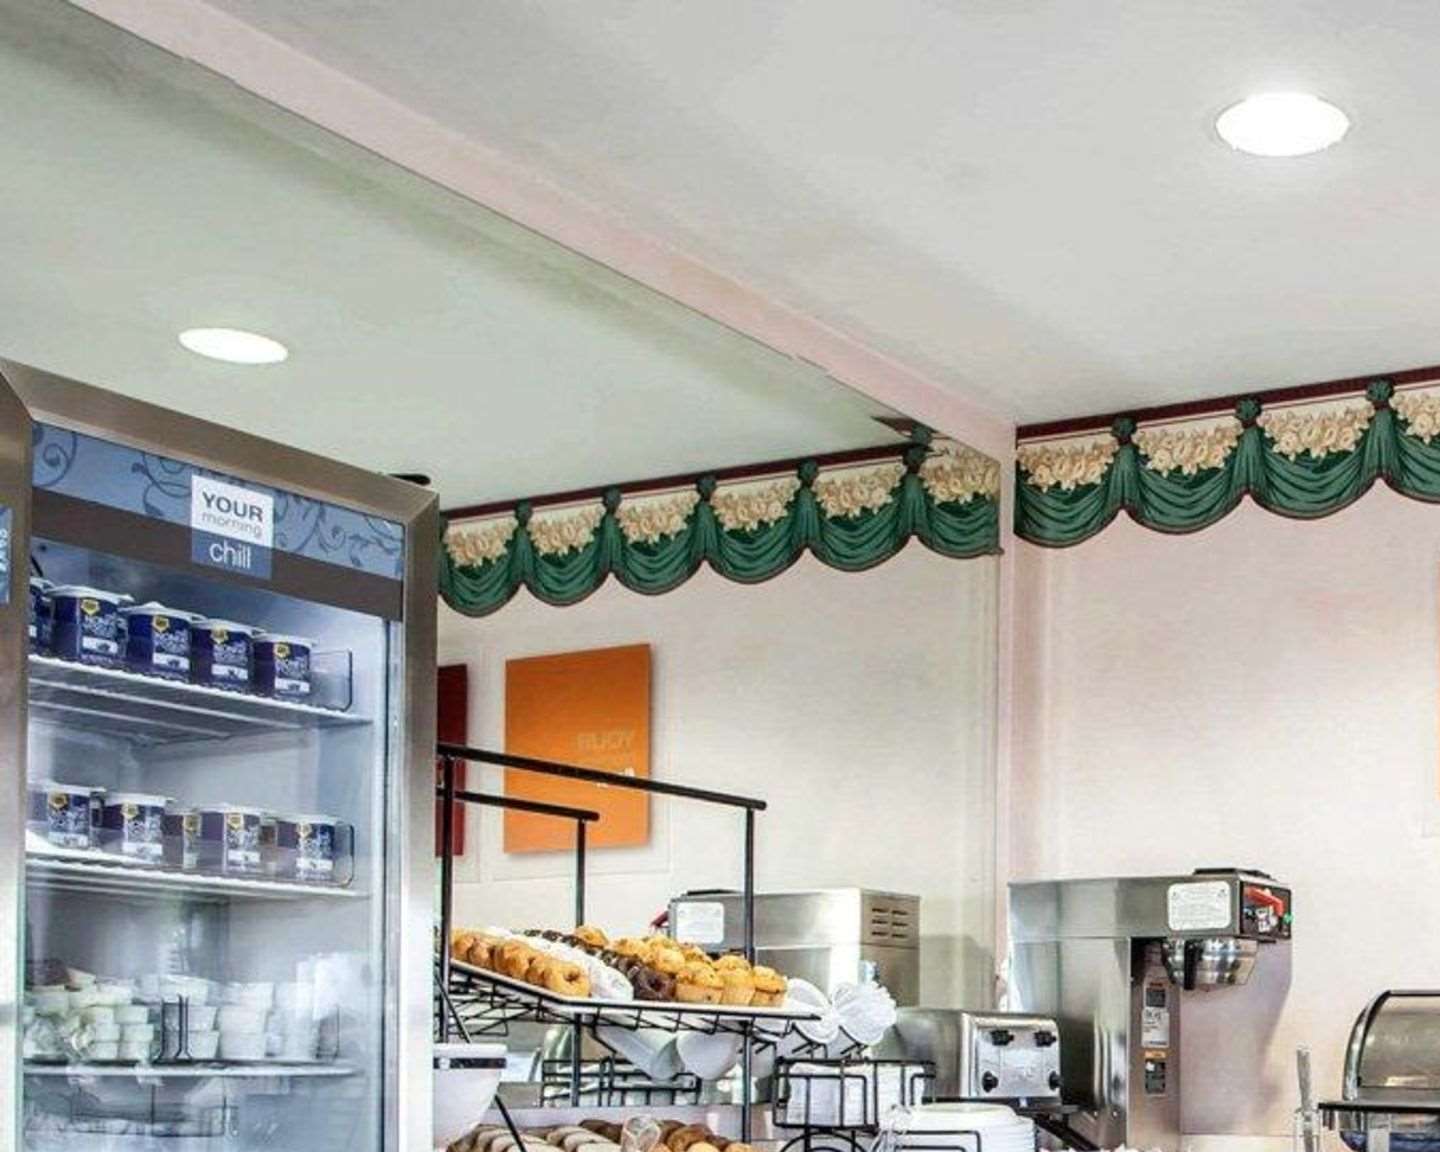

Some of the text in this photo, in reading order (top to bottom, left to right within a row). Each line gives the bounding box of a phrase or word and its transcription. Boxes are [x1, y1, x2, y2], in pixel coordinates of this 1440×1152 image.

[202, 491, 264, 522] YOUR
[202, 512, 262, 538] morning
[209, 540, 251, 569] chill
